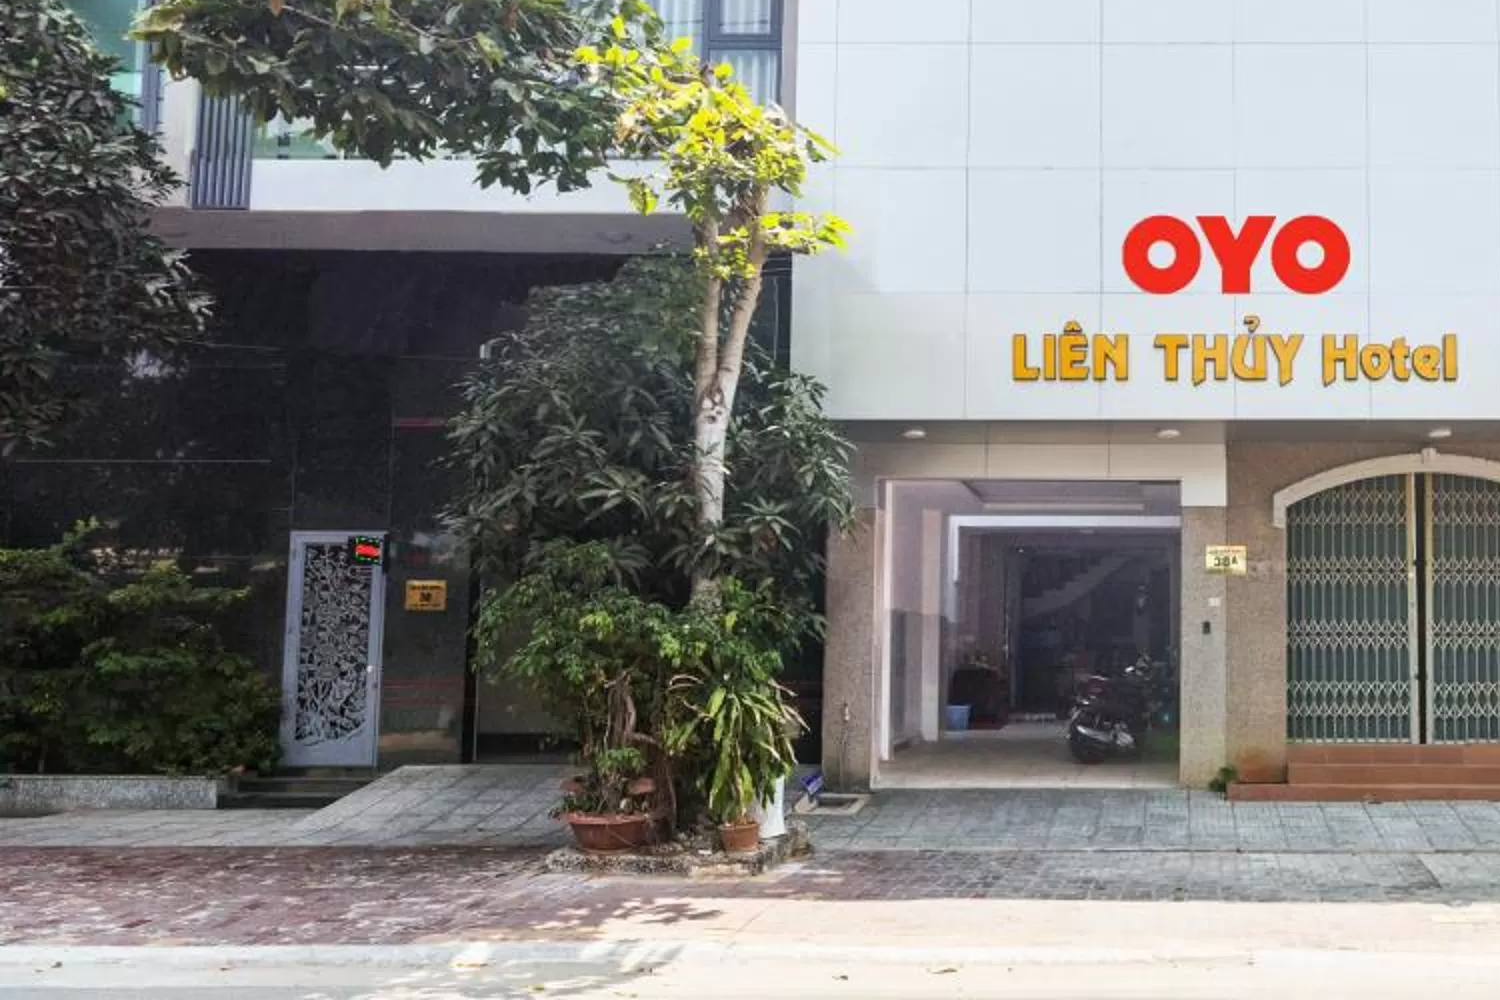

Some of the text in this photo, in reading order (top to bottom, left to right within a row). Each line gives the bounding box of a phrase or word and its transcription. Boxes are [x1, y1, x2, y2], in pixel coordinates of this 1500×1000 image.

[1121, 214, 1351, 295] OYO
[1012, 315, 1459, 387] LIÊN THỦY Hotel
